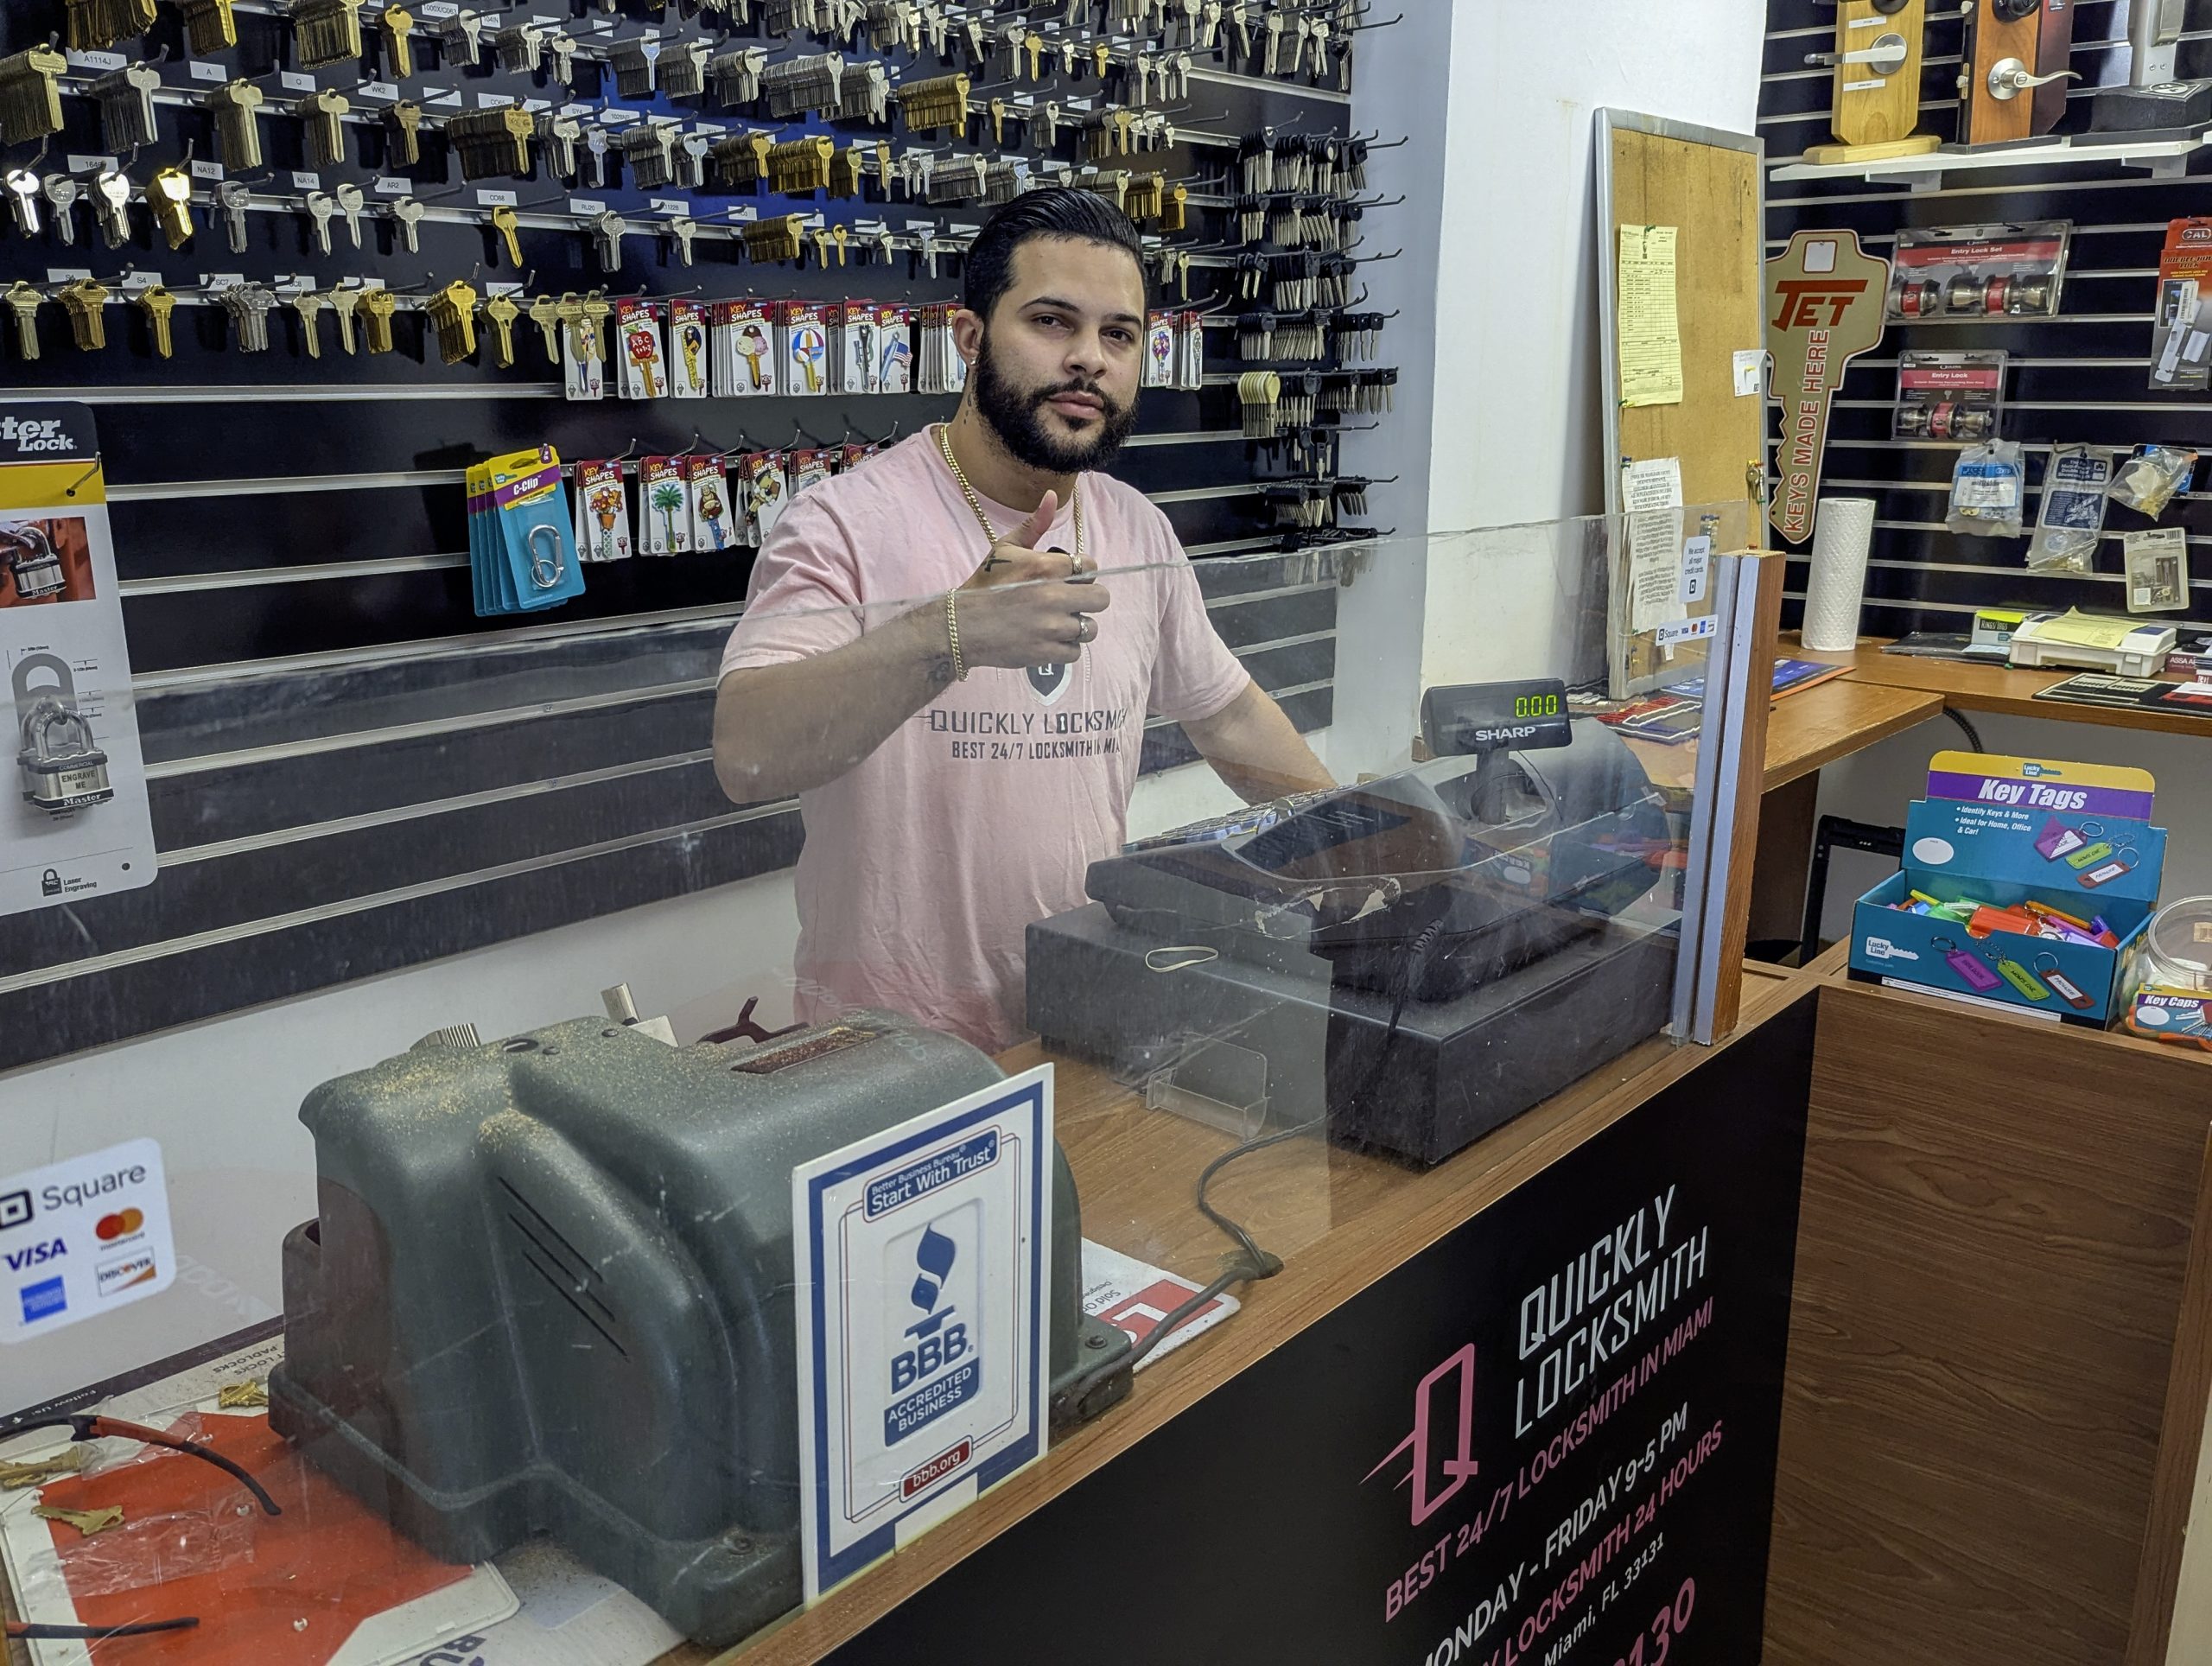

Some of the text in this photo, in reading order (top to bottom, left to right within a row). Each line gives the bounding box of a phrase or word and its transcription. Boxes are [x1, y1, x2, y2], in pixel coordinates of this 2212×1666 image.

[84, 54, 111, 66] A1114J
[206, 68, 213, 77] A
[372, 86, 387, 95] WK2
[197, 165, 216, 175] NA12
[296, 175, 315, 186] NA14
[386, 181, 400, 189] AR2
[581, 203, 596, 212] RU20
[620, 305, 634, 314] KEY
[674, 305, 688, 315] KEY
[729, 302, 744, 315] KEY
[790, 306, 804, 316] KEY
[847, 306, 861, 315] KEY
[1771, 279, 1868, 332] JET
[621, 309, 650, 322] SHAPES
[675, 313, 700, 323] SHAPES
[731, 309, 762, 322] SHAPES
[791, 313, 818, 322] SHAPES
[848, 313, 874, 322] SHAPES
[880, 309, 893, 318] KEY
[881, 315, 904, 325] SHAPES
[1783, 328, 1830, 533] KEYS MADE HERE
[692, 461, 705, 472] KEY
[752, 459, 764, 469] KEY
[799, 455, 811, 465] KEY
[799, 460, 824, 473] SHAPES
[583, 466, 599, 478] KEY
[650, 462, 663, 473] KEY
[693, 466, 719, 480] SHAPES
[585, 471, 615, 486] SHAPES
[651, 468, 677, 481] SHAPES
[1664, 629, 1679, 639] Square
[1516, 694, 1559, 718] 0.00
[931, 709, 1035, 734] QUICKLY
[1475, 725, 1536, 741] SHARP
[951, 740, 1093, 760] BEST 24/7 LOCKSMITH
[61, 772, 95, 783] ENGRAVE
[63, 793, 101, 806] Master
[1978, 779, 2088, 811] Key Tags
[1961, 805, 1986, 817] Identify
[1986, 810, 2003, 819] Keys
[2011, 811, 2030, 821] More
[1960, 817, 2032, 832] Ideal for Home, Office
[1964, 827, 1979, 836] Car!
[63, 876, 82, 885] Laser
[64, 881, 98, 893] Engraving
[1868, 939, 1890, 950] Lucky
[1870, 947, 1885, 956] Line
[2145, 995, 2200, 1008] Key Caps
[872, 1178, 898, 1195] Better
[899, 1163, 933, 1184] Business
[43, 1165, 146, 1211] Square
[872, 1182, 912, 1212] Start
[916, 1166, 950, 1192] With
[4, 1237, 68, 1271] VISA
[99, 1256, 152, 1282] DISCOVER
[1519, 1184, 1676, 1361] QUICKLY
[1097, 1288, 1122, 1305] Sold
[1514, 1225, 1709, 1440] LOCKSMITH
[213, 1345, 278, 1373] PADLOCKS
[234, 1357, 275, 1376] LOCKS
[887, 1365, 973, 1422] ACCREDITED
[898, 1385, 963, 1432] BUSINESS
[1385, 1296, 1714, 1624] BEST 24/7 LOCKSMITH IN MIAMI
[912, 1448, 962, 1489] bbb.org
[1544, 1474, 1629, 1570] FRIDAY
[1624, 1438, 1656, 1492] 9-5
[1660, 1402, 1689, 1454] PM
[1505, 1420, 1723, 1663] LOCKSMITH 24 HOURS
[1545, 1532, 1665, 1666] Miami, FL 33131
